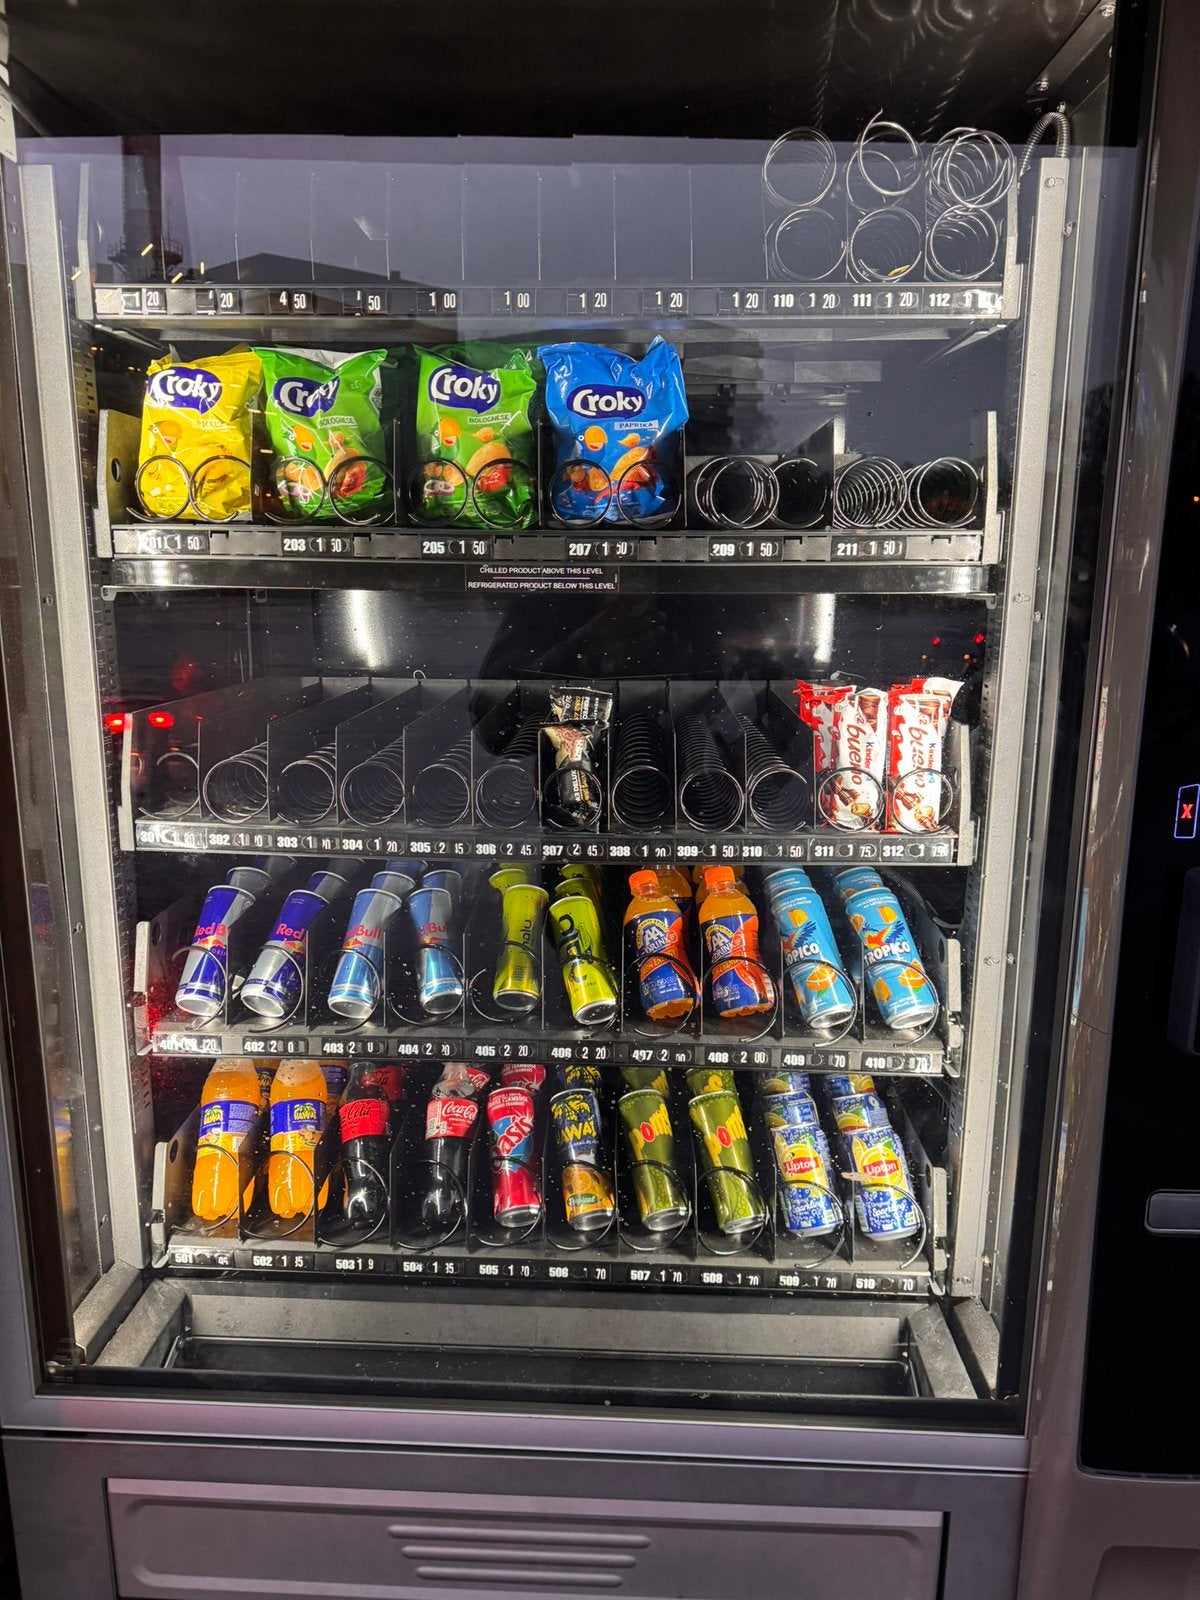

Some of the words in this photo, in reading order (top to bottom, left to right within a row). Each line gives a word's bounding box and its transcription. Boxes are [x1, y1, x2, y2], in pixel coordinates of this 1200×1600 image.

[146, 292, 160, 306] 20
[220, 292, 233, 308] 20
[279, 290, 287, 306] 4
[294, 294, 306, 309] 50
[368, 295, 380, 311] 50
[429, 292, 436, 306] 1
[444, 292, 456, 308] 00
[504, 291, 510, 306] 1
[517, 292, 530, 308] 00
[580, 293, 586, 308] 1
[594, 292, 607, 308] 20
[655, 290, 661, 305] 1
[670, 292, 682, 308] 20
[732, 292, 739, 308] 1
[745, 293, 758, 309] 20
[773, 293, 794, 307] 110
[810, 293, 815, 308] 1
[822, 294, 836, 309] 20
[852, 293, 872, 307] 111
[886, 293, 892, 308] 1
[899, 292, 912, 306] 20
[929, 293, 950, 307] 112
[150, 368, 222, 402] Croky
[430, 368, 498, 403] Croky
[573, 388, 643, 416] Croky
[469, 414, 510, 424] BOLOGNESE
[618, 421, 654, 430] PAPRIKA
[187, 536, 200, 550] 50
[283, 538, 306, 552] 203
[316, 538, 323, 552] 1
[330, 538, 342, 552] 50
[422, 541, 445, 554] 205
[459, 540, 465, 554] 1
[472, 540, 486, 555] 50
[569, 544, 592, 556] 207
[602, 542, 608, 556] 1
[712, 544, 735, 556] 209
[746, 542, 752, 556] 1
[760, 542, 772, 557] 50
[836, 543, 857, 556] 211
[869, 542, 876, 555] 1
[883, 541, 895, 555] 50
[594, 582, 616, 590] LEVEL
[864, 741, 874, 769] Kinder
[209, 834, 230, 845] 302
[277, 836, 298, 848] 303
[307, 836, 313, 848] 1
[342, 839, 363, 850] 304
[374, 839, 380, 851] 1
[386, 840, 398, 853] 20
[410, 842, 430, 852] 305
[439, 842, 446, 853] 2
[476, 843, 496, 854] 306
[506, 843, 513, 856] 2
[520, 844, 532, 856] 45
[543, 844, 564, 856] 307
[573, 843, 579, 855] 2
[587, 844, 598, 856] 45
[610, 845, 630, 856] 308
[642, 846, 648, 857] 1
[677, 845, 698, 856] 309
[711, 844, 716, 856] 1
[722, 845, 734, 857] 50
[743, 846, 762, 857] 310
[790, 846, 802, 858] 50
[814, 845, 834, 856] 311
[860, 846, 871, 857] 75
[883, 845, 904, 856] 312
[276, 923, 305, 940] Red
[355, 925, 382, 939] Bull
[645, 937, 669, 954] DRINK
[864, 941, 911, 965] TROPICO
[244, 1040, 264, 1051] 402
[270, 1040, 278, 1052] 2
[323, 1042, 344, 1053] 403
[349, 1041, 356, 1054] 2
[398, 1044, 419, 1055] 404
[425, 1043, 432, 1055] 2
[475, 1045, 496, 1056] 405
[504, 1044, 510, 1056] 2
[518, 1044, 529, 1056] 20
[551, 1047, 572, 1058] 406
[582, 1047, 588, 1059] 2
[596, 1047, 606, 1059] 20
[660, 1049, 668, 1061] 2
[708, 1052, 729, 1063] 408
[740, 1051, 747, 1063] 2
[754, 1052, 765, 1064] 00
[784, 1054, 805, 1066] 409
[834, 1055, 845, 1067] 70
[865, 1058, 886, 1069] 410
[786, 1158, 817, 1173] Lipton
[866, 1161, 898, 1176] Lipton
[175, 1252, 193, 1263] 501
[252, 1255, 272, 1266] 502
[336, 1259, 354, 1270] 503
[403, 1261, 422, 1272] 504
[479, 1264, 498, 1275] 505
[549, 1267, 568, 1278] 506
[596, 1268, 606, 1280] 70
[630, 1270, 650, 1280] 507
[672, 1271, 682, 1282] 70
[703, 1272, 723, 1283] 508
[779, 1275, 799, 1286] 509
[855, 1278, 875, 1289] 510
[902, 1279, 913, 1290] 70
